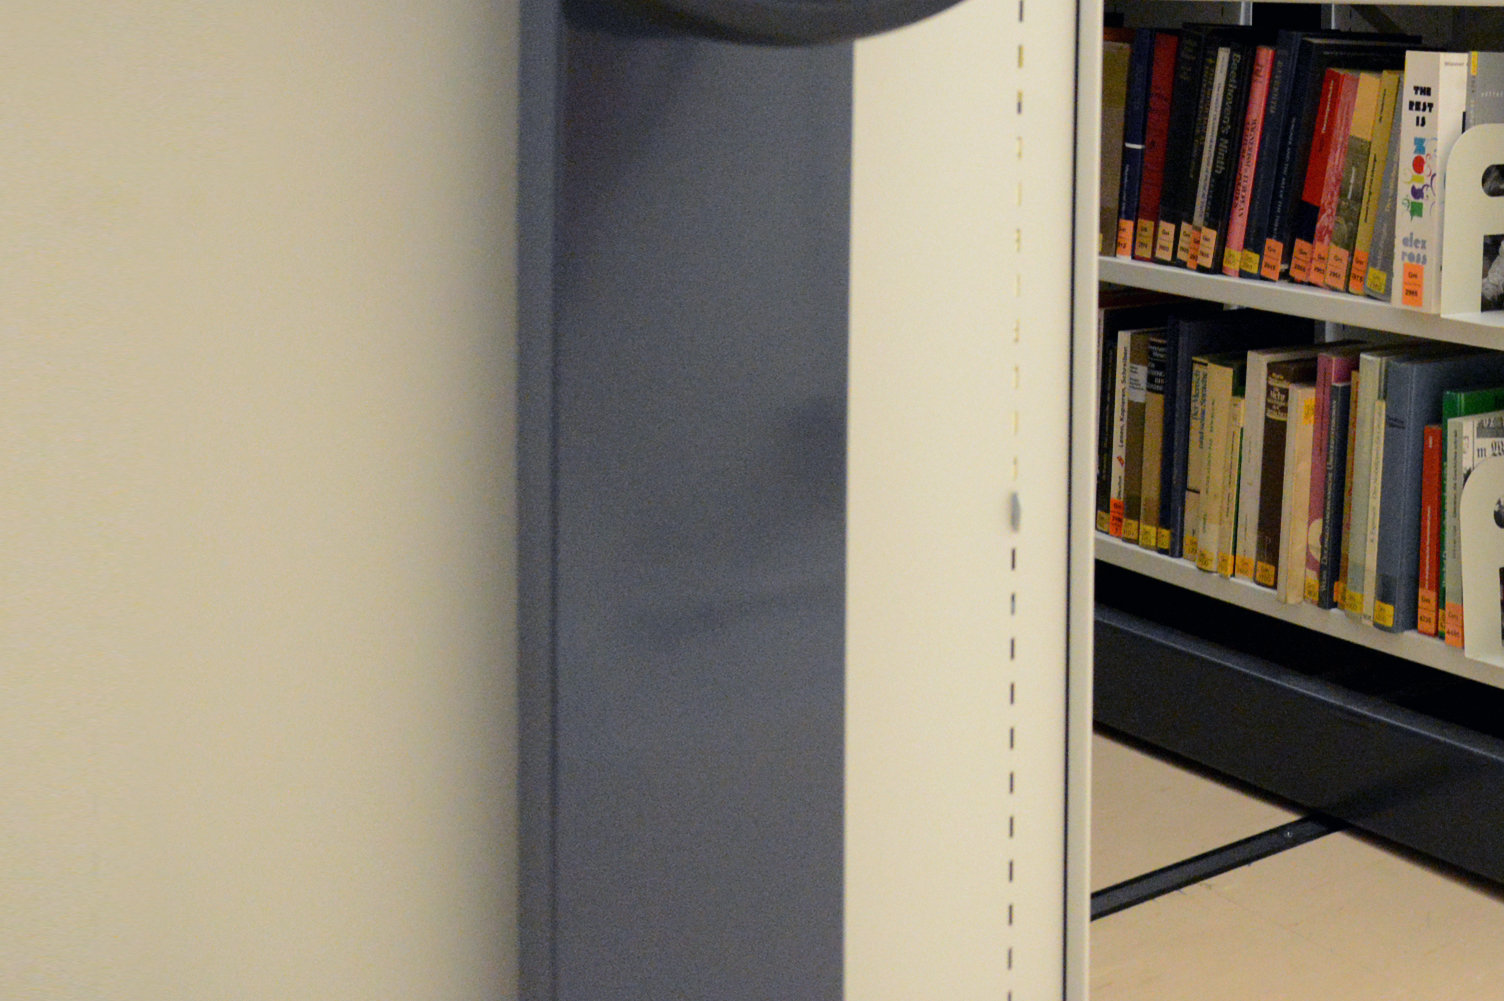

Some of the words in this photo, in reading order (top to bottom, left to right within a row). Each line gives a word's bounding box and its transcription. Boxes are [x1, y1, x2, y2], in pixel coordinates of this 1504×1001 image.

[1222, 52, 1241, 135] Beethoven's
[1414, 86, 1432, 96] THE
[1408, 100, 1434, 112] REST
[1416, 116, 1426, 127] IS
[1214, 138, 1229, 174] Ninth
[1402, 232, 1427, 249] alex
[1401, 252, 1427, 266] ross
[1200, 373, 1208, 406] Sprache
